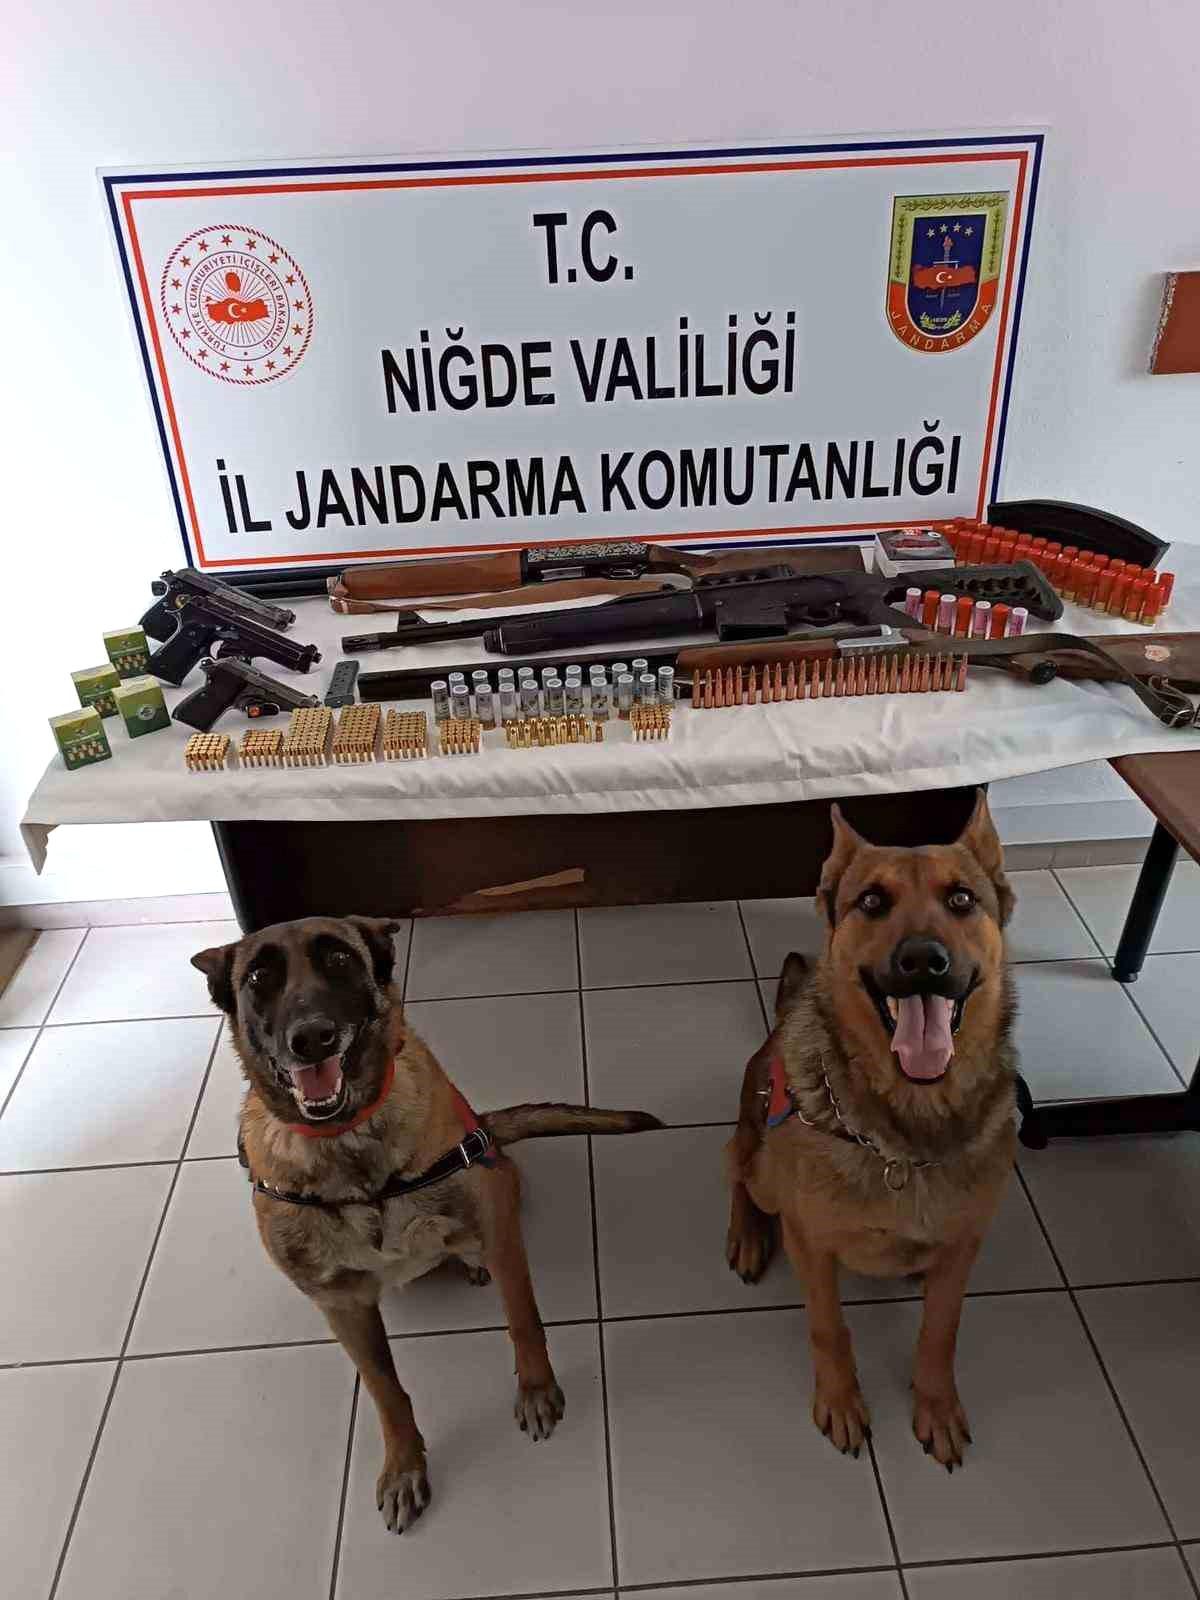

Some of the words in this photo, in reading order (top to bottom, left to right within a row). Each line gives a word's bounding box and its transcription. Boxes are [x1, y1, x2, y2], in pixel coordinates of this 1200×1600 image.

[533, 210, 634, 284] T.C.
[190, 254, 236, 308] CUMHURİYETİ
[239, 254, 279, 292] İÇİŞLERİ
[261, 293, 288, 351] BAKANLIĞI
[891, 302, 993, 351] JANDARMA
[382, 327, 555, 413] NİĞDE
[570, 312, 796, 403] VALİLİĞİ
[216, 459, 273, 533] İL
[286, 455, 587, 530] JANDARMA
[600, 419, 962, 513] KOMUTANLIĞI
